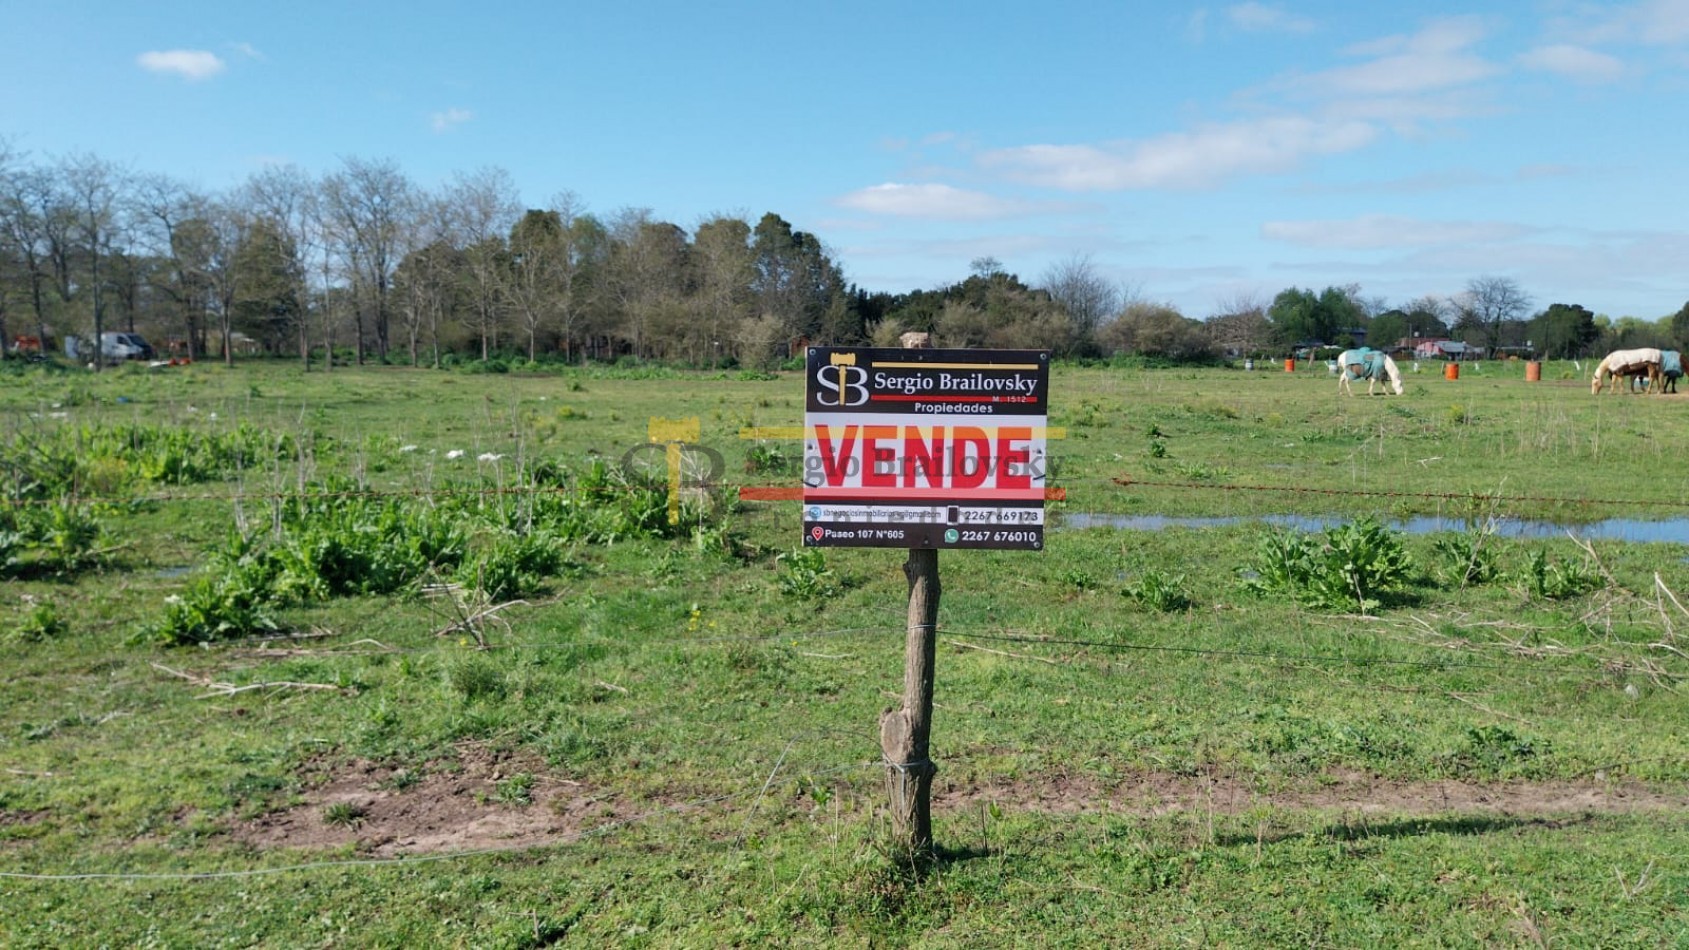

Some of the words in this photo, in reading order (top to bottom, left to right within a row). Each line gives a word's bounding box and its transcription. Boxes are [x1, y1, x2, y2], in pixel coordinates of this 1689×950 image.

[874, 372, 934, 394] Sergio
[939, 373, 1038, 396] Brailovsky
[915, 402, 993, 414] Propiedades
[814, 424, 1032, 489] VENDE
[964, 511, 992, 520] 2267
[996, 511, 1038, 521] 669173
[825, 529, 855, 539] Paseo
[858, 530, 874, 539] 107
[962, 531, 990, 541] 2267
[994, 532, 1037, 542] 676010
